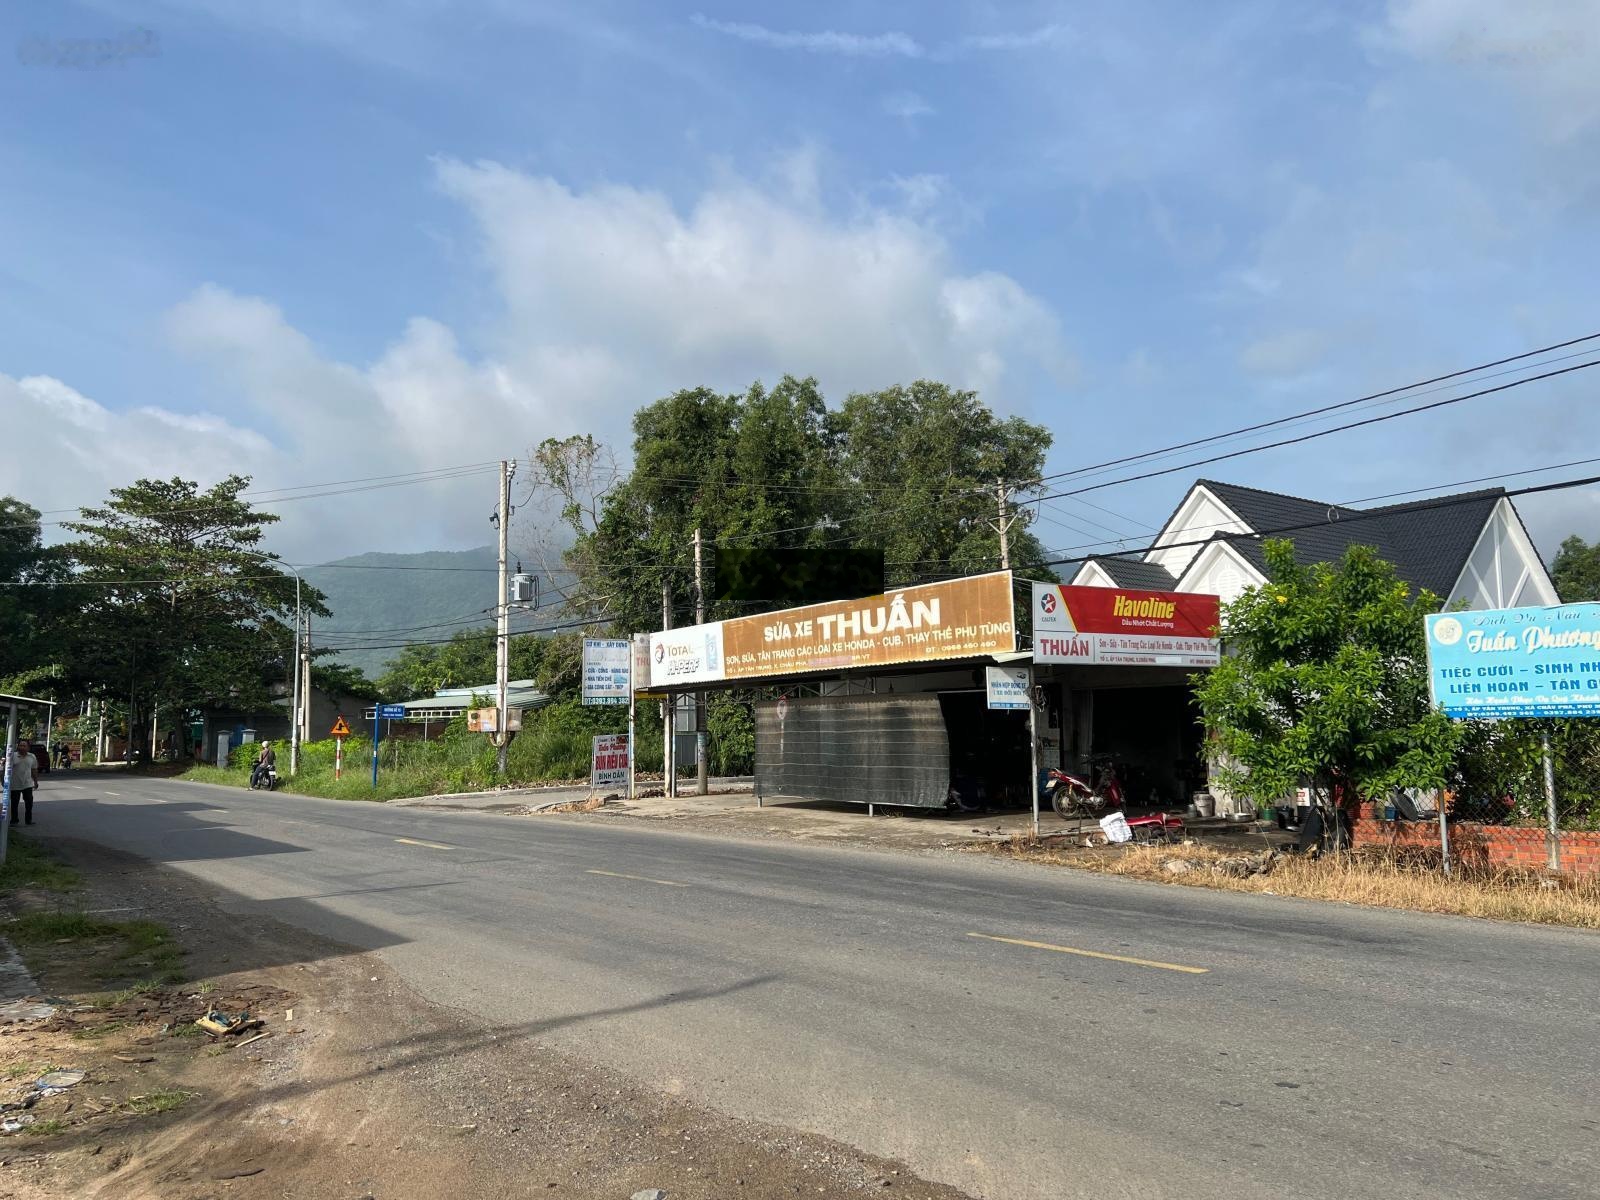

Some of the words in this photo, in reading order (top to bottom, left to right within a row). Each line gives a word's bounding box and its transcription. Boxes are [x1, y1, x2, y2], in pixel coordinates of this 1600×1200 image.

[764, 621, 792, 642] SỬA
[794, 620, 813, 638] XE
[816, 593, 941, 640] THUẤN
[1113, 595, 1175, 618] Havoline
[772, 648, 796, 659] TRANG
[796, 645, 812, 657] CÁC
[832, 642, 843, 653] XE
[845, 639, 876, 651] HONDA
[882, 635, 904, 647] CUB,
[906, 630, 931, 643] THAY
[932, 625, 953, 640] THẾ
[955, 625, 977, 638] PHỤ
[979, 621, 1011, 636] TÙNG
[1040, 633, 1089, 657] THUẤN
[1466, 629, 1519, 654] Tuấn
[1534, 663, 1574, 675] SINH
[1487, 680, 1529, 693] HOAN
